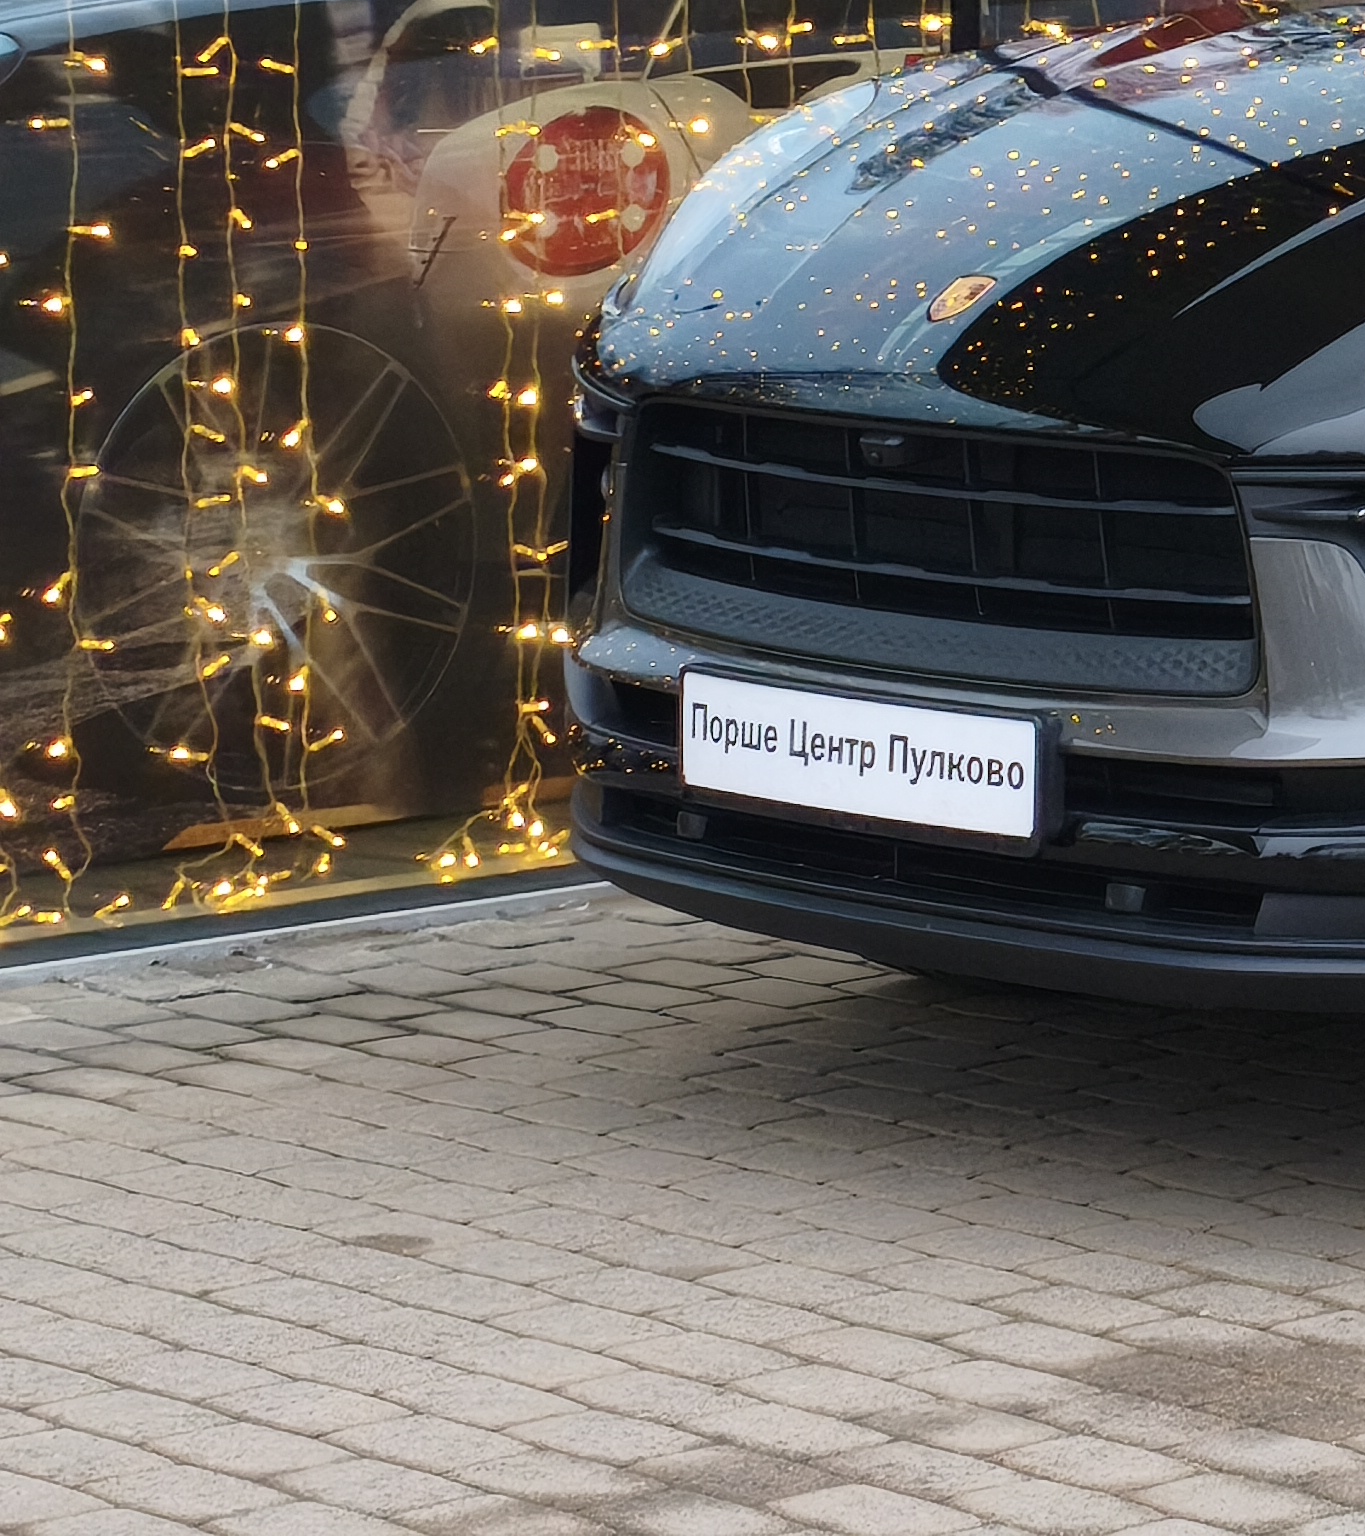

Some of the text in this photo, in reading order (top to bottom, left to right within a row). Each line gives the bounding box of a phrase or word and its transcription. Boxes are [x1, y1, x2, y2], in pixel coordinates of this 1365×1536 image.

[691, 702, 1025, 790] Порше Центр Пулково
